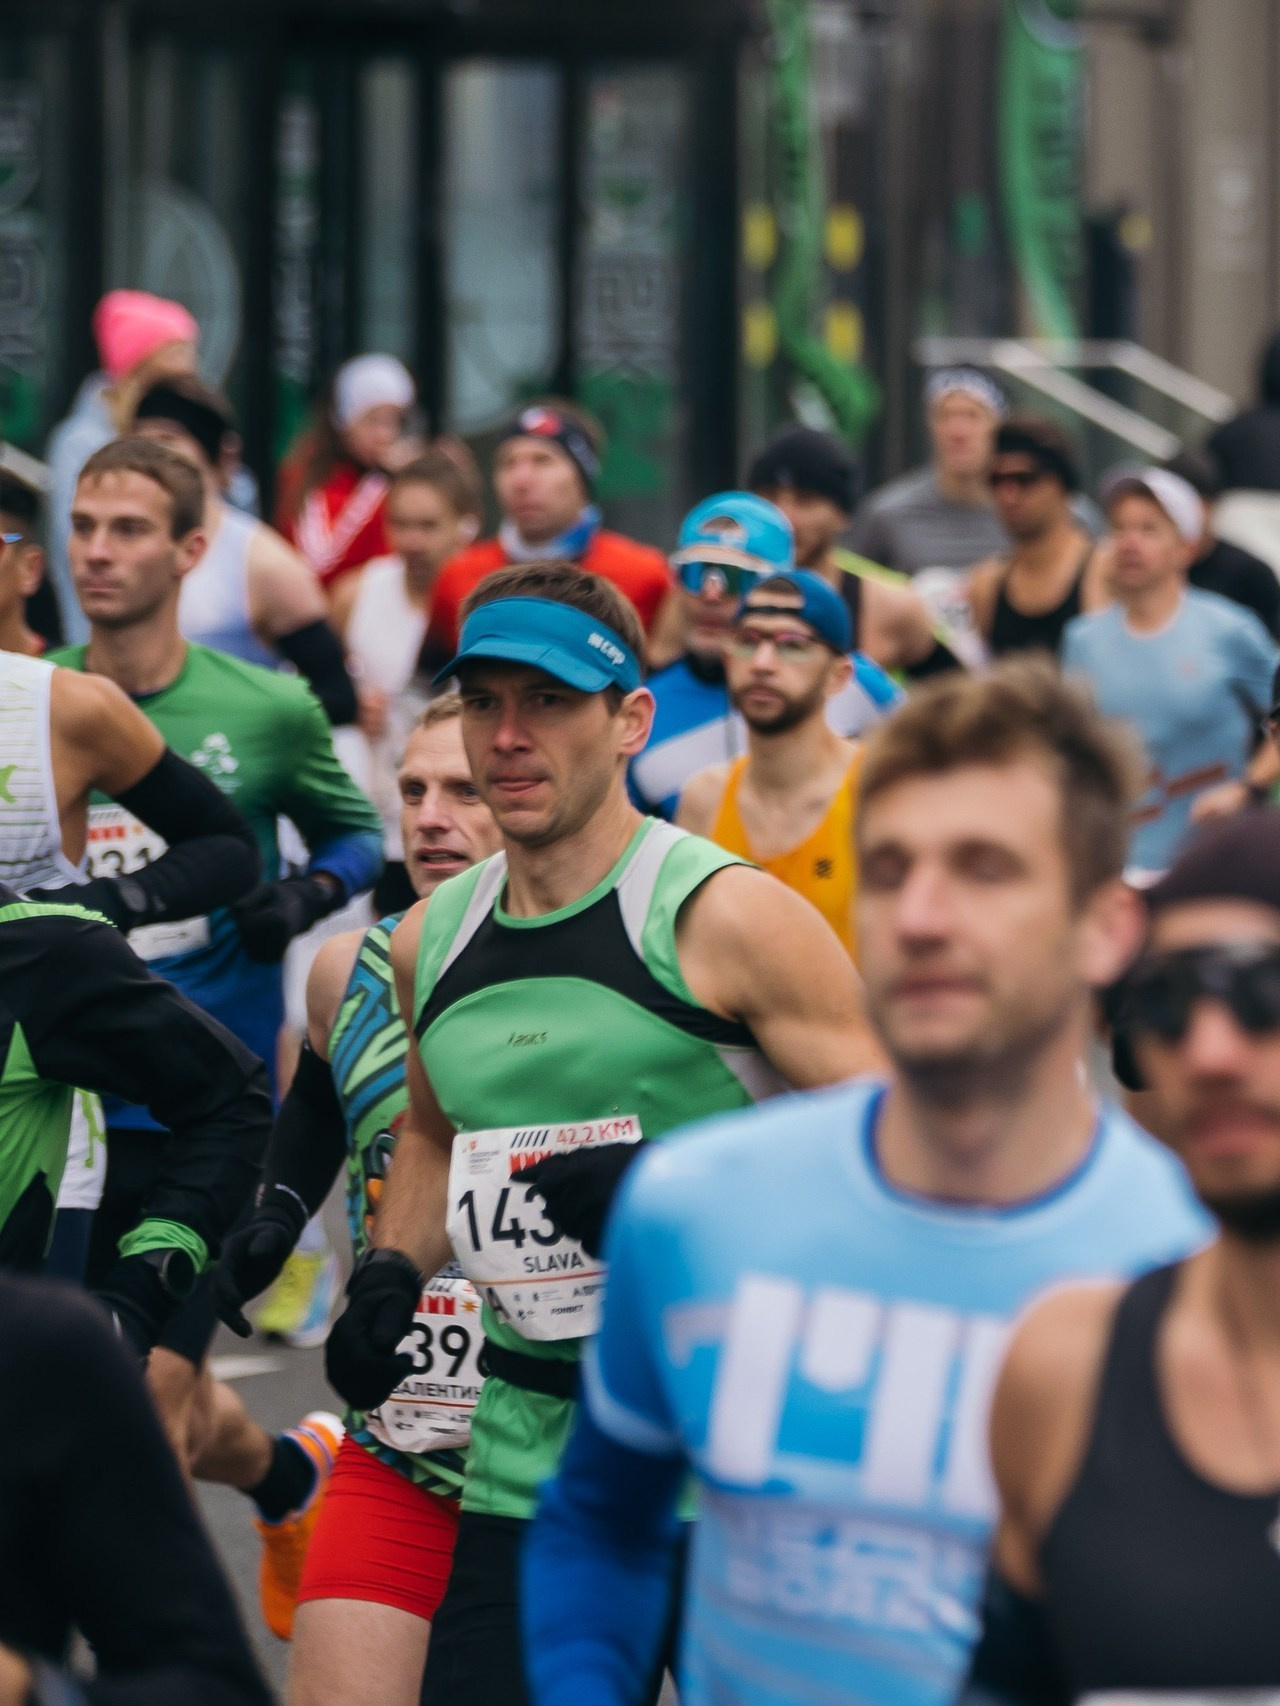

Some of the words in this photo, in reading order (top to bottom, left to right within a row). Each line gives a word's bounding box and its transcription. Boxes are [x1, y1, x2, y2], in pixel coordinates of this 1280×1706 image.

[457, 1185, 564, 1252] 143
[522, 1252, 586, 1274] SLAVA
[393, 1381, 483, 1400] АЛЕНТИН
